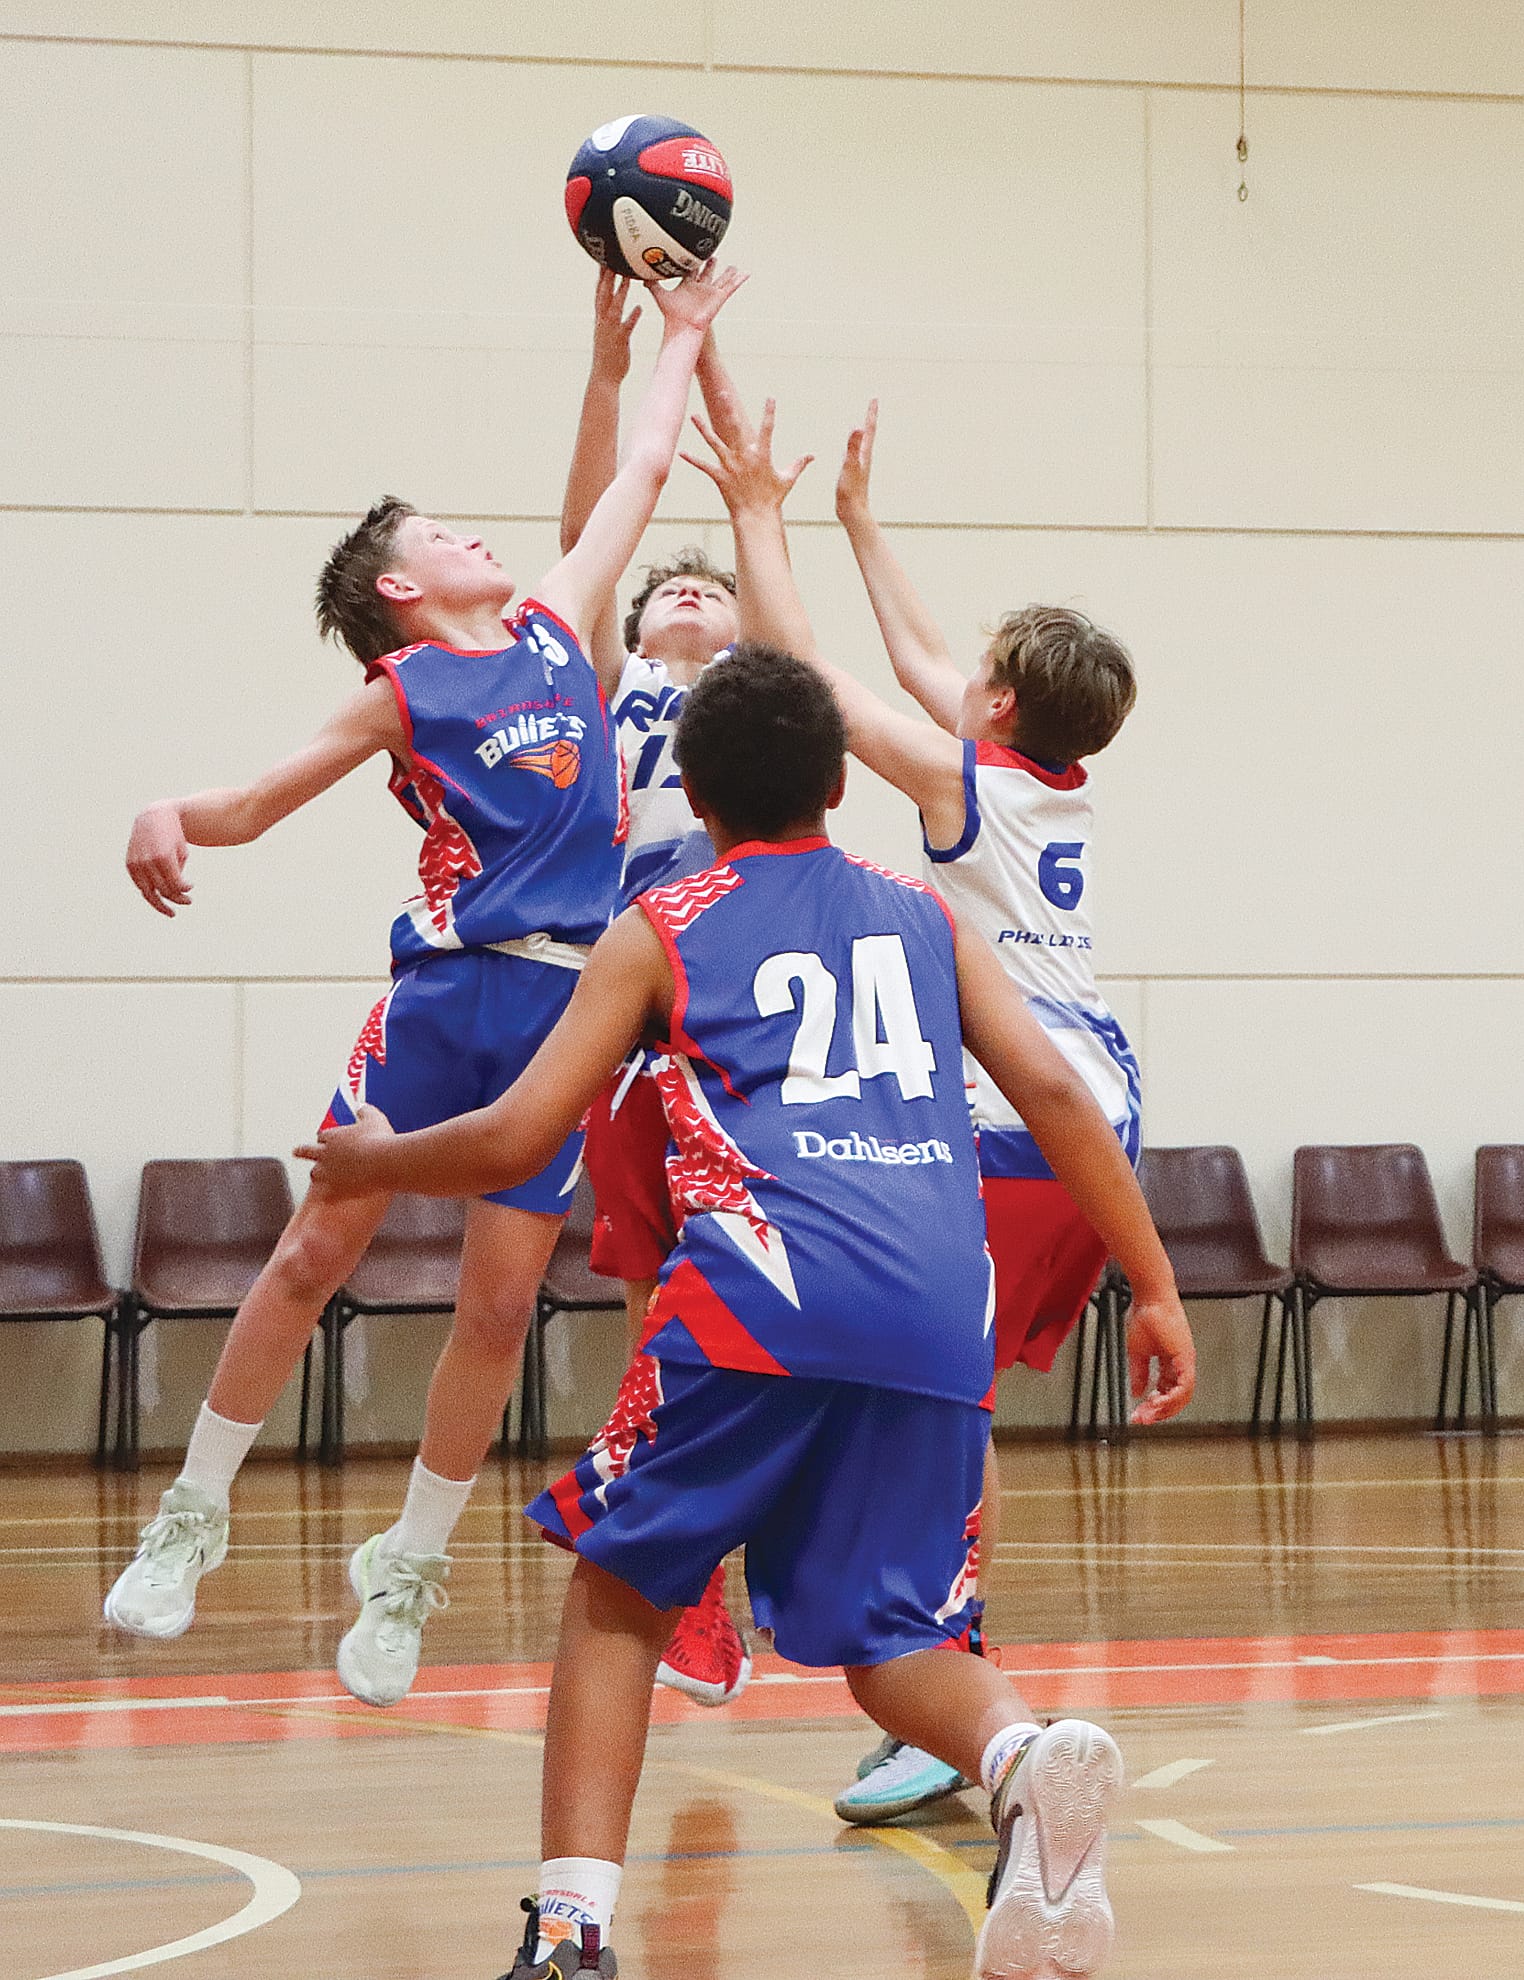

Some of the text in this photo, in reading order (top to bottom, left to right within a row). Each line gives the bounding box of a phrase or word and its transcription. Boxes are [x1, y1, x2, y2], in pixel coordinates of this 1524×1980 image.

[632, 734, 685, 790] 1
[1037, 842, 1085, 911] 6
[753, 934, 937, 1105] 24
[792, 1130, 954, 1165] Dahlsens
